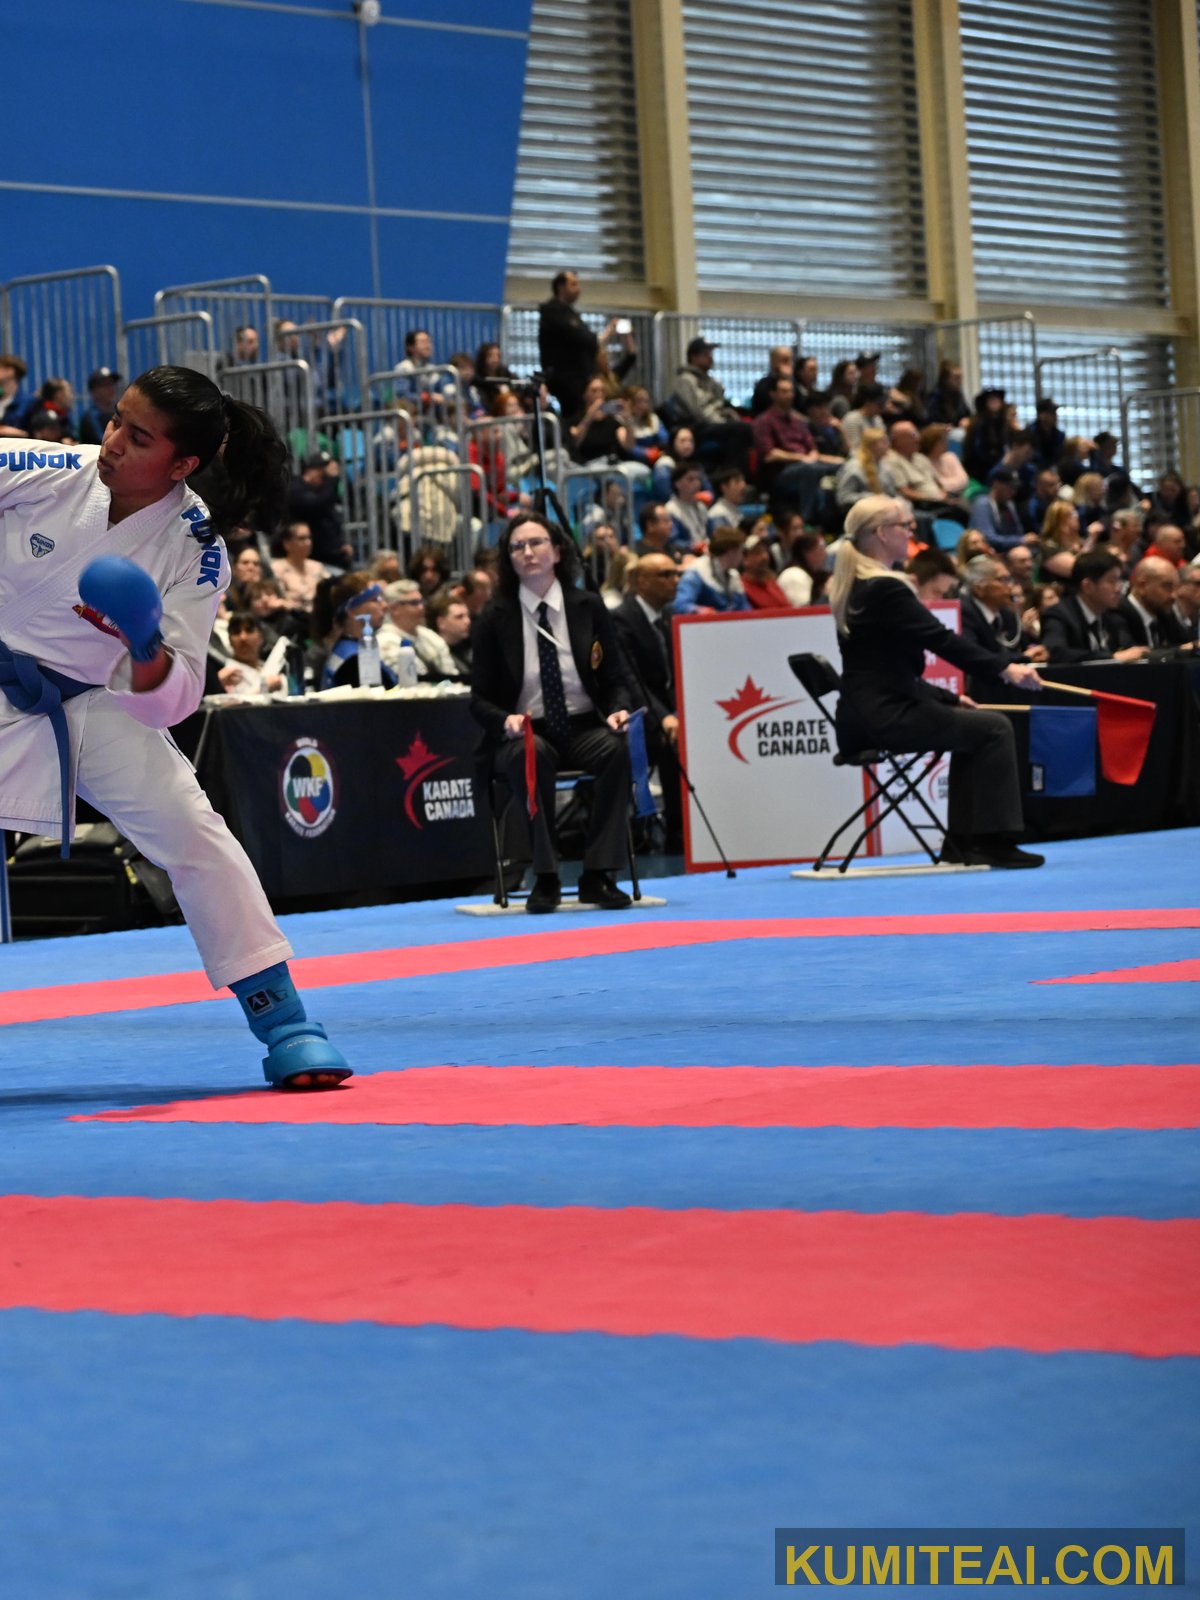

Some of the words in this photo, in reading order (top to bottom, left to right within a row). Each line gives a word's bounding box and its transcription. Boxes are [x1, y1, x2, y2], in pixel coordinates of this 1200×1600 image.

[757, 719, 828, 738] KARATE
[758, 738, 830, 757] CANADA
[292, 776, 324, 798] WKF
[423, 778, 473, 801] KARATE
[424, 799, 475, 820] CANADA
